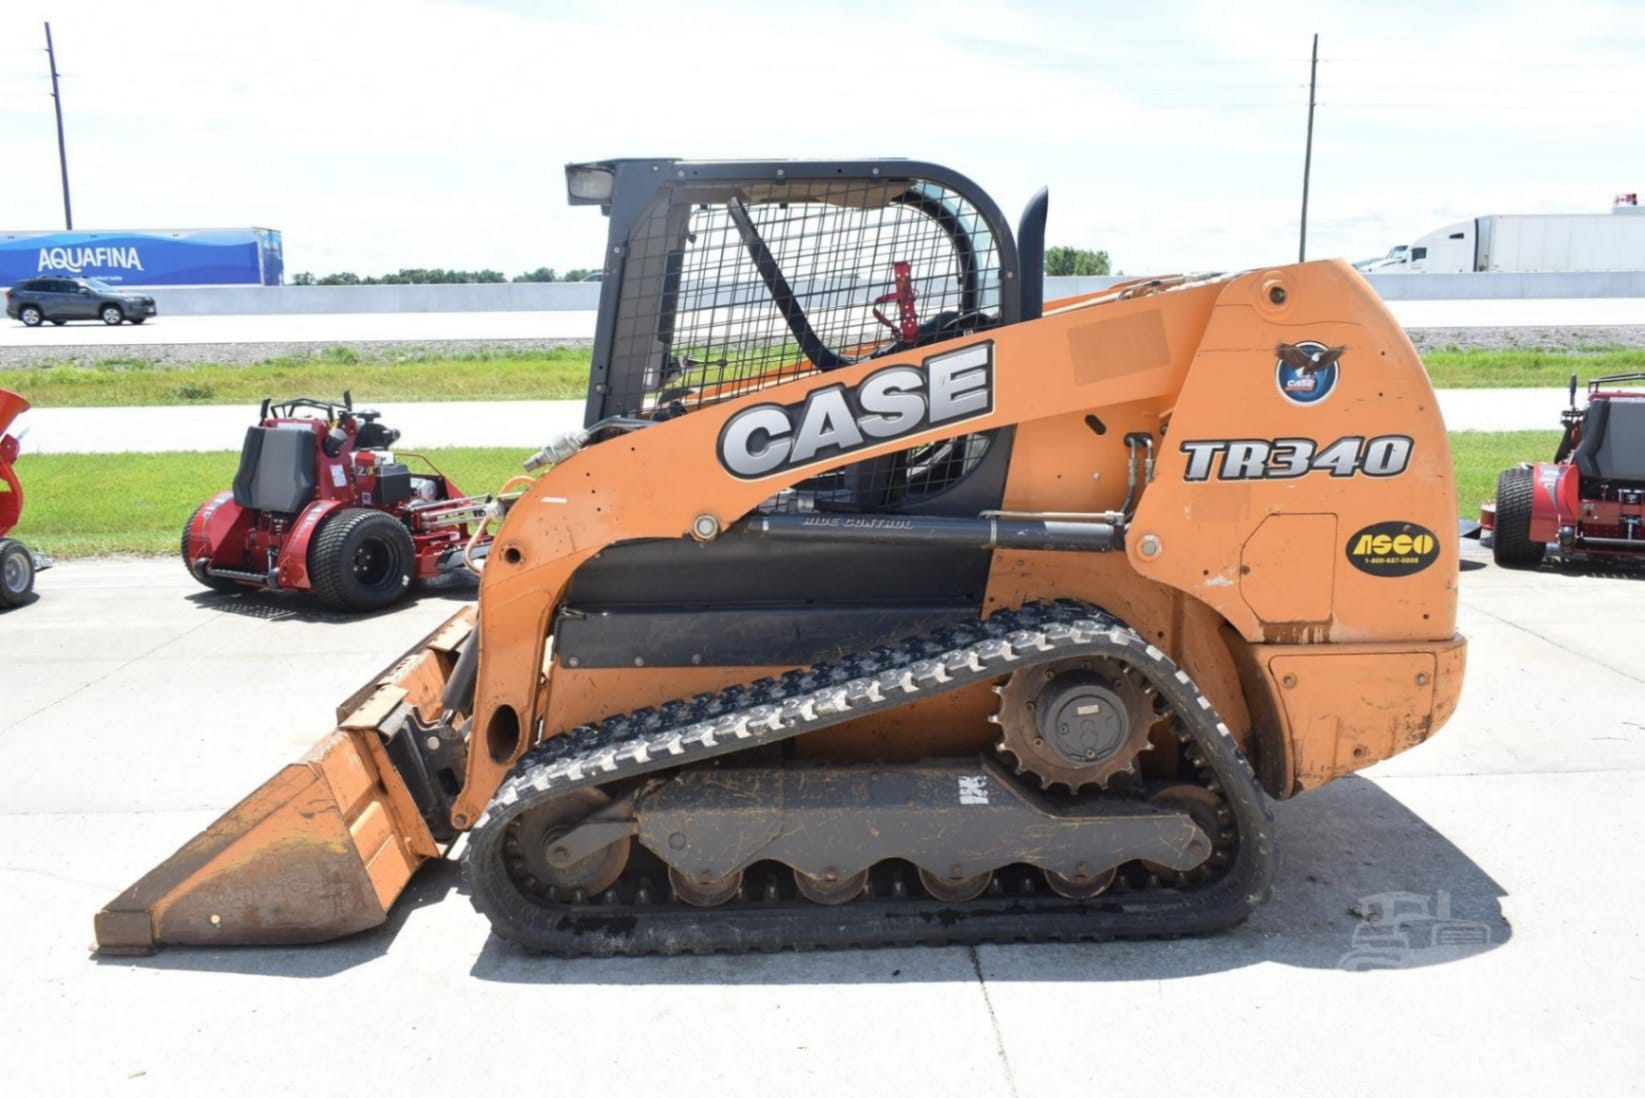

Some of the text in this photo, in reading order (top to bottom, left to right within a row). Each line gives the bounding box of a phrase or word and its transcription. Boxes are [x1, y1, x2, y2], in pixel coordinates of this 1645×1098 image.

[37, 247, 144, 273] AQUAFINA
[717, 339, 994, 479] CASE
[1181, 435, 1414, 481] TR340
[843, 518, 913, 530] CONTROL
[1352, 534, 1434, 555] ASCO
